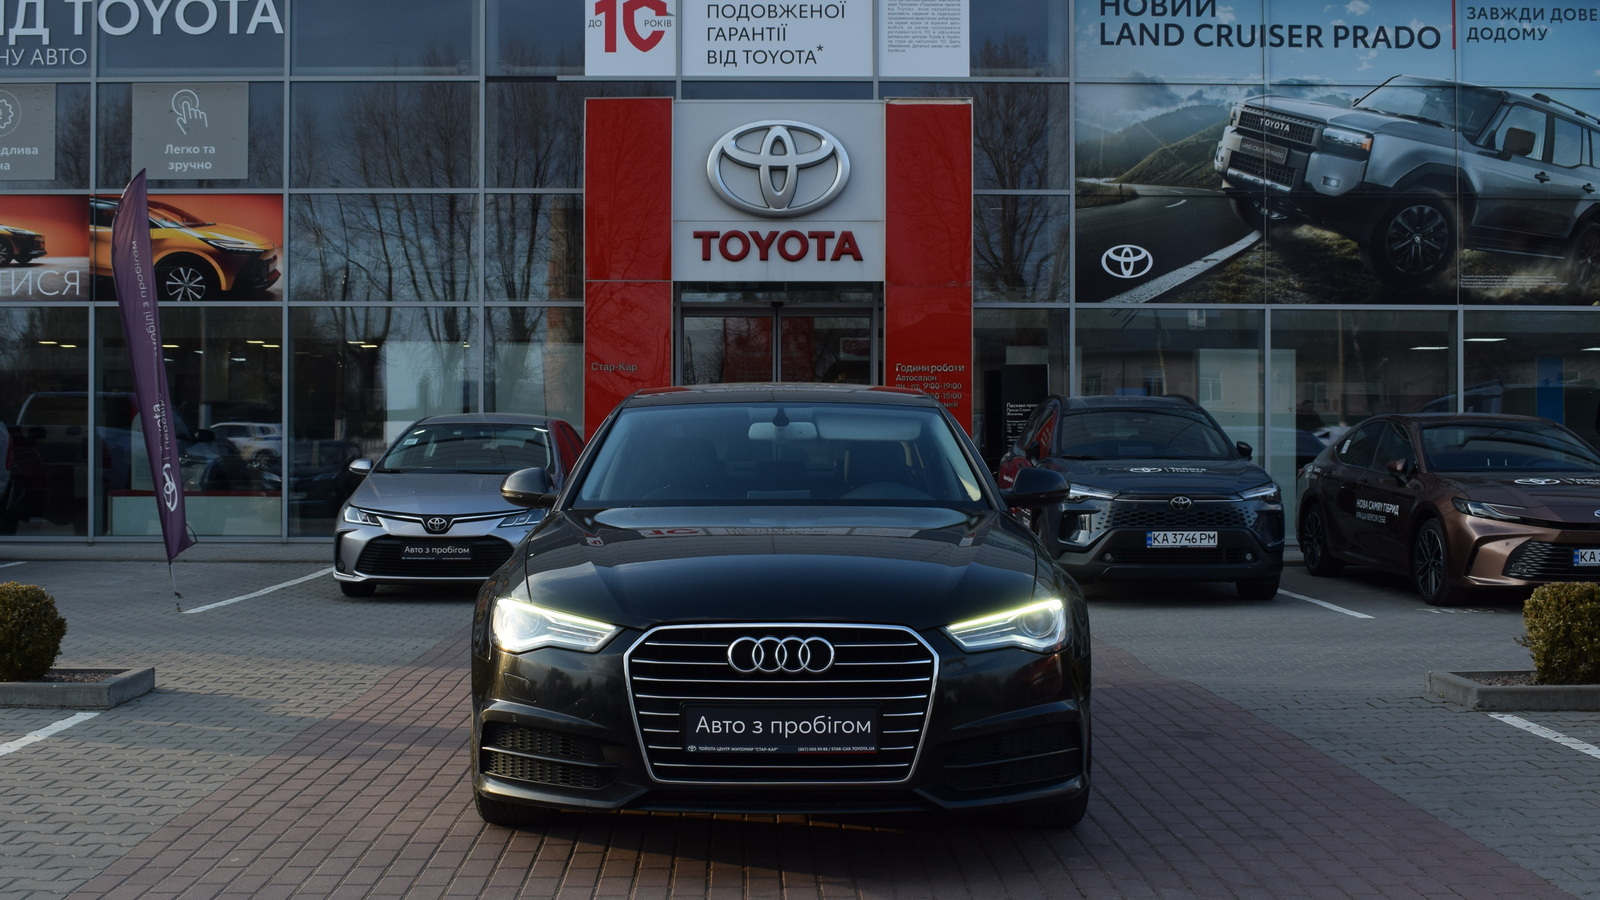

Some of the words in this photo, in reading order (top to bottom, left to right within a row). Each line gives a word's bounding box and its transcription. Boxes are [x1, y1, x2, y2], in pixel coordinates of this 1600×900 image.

[64, 0, 284, 36] TOYOTA
[707, 0, 847, 21] ПОДОВЖЕНОЇ
[1467, 7, 1545, 23] ЗАВЖДИ
[1550, 8, 1600, 23] ДОВЕ
[588, 19, 603, 28] ДО
[644, 19, 672, 28] РОКІВ
[707, 23, 788, 41] ГАРАНТІЇ
[1100, 22, 1185, 46] LAND
[1193, 23, 1324, 48] CRUISER
[1333, 25, 1441, 49] PRADO
[1467, 27, 1548, 43] ДОДОМУ
[30, 48, 87, 65] АВТО
[707, 50, 738, 67] ВІД
[1260, 118, 1290, 132] TOYOTA
[165, 144, 200, 155] Легко
[203, 146, 216, 155] та
[168, 161, 213, 172] зручно
[693, 230, 864, 262] TOYOTA
[132, 240, 147, 299] пробігом
[0, 270, 80, 296] ТИСЯ
[591, 362, 638, 374] Стар-Кар
[896, 363, 930, 373] Години
[930, 363, 965, 373] роботи
[1153, 533, 1168, 544] KA
[1172, 533, 1198, 544] 3746
[1200, 533, 1216, 544] PM
[432, 546, 470, 554] пробігом
[696, 716, 745, 734] Авто
[752, 721, 763, 734] з
[771, 716, 870, 738] пробігом
